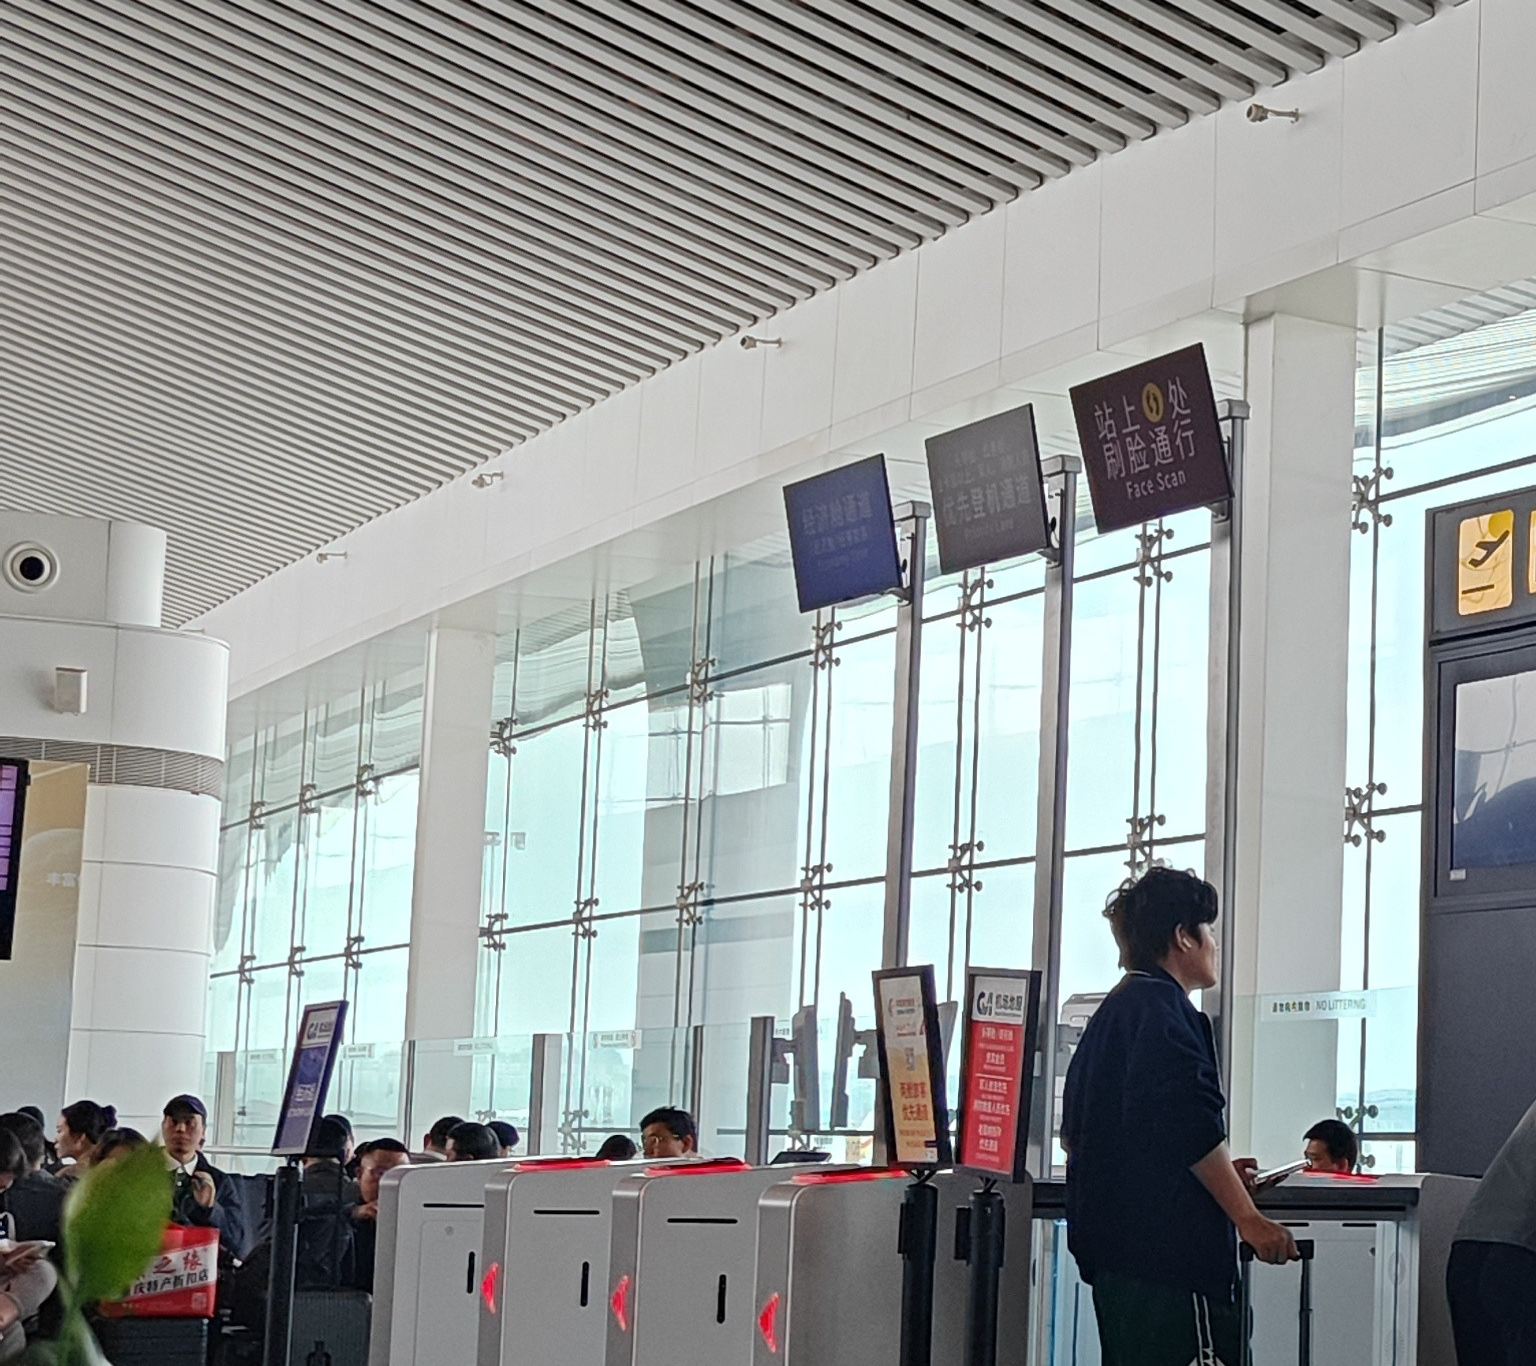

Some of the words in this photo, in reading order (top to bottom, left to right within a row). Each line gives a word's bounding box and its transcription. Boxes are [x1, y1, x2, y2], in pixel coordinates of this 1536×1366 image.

[1103, 419, 1195, 481] 刷脸通行
[1126, 479, 1154, 499] Face
[1156, 470, 1187, 492] Scan
